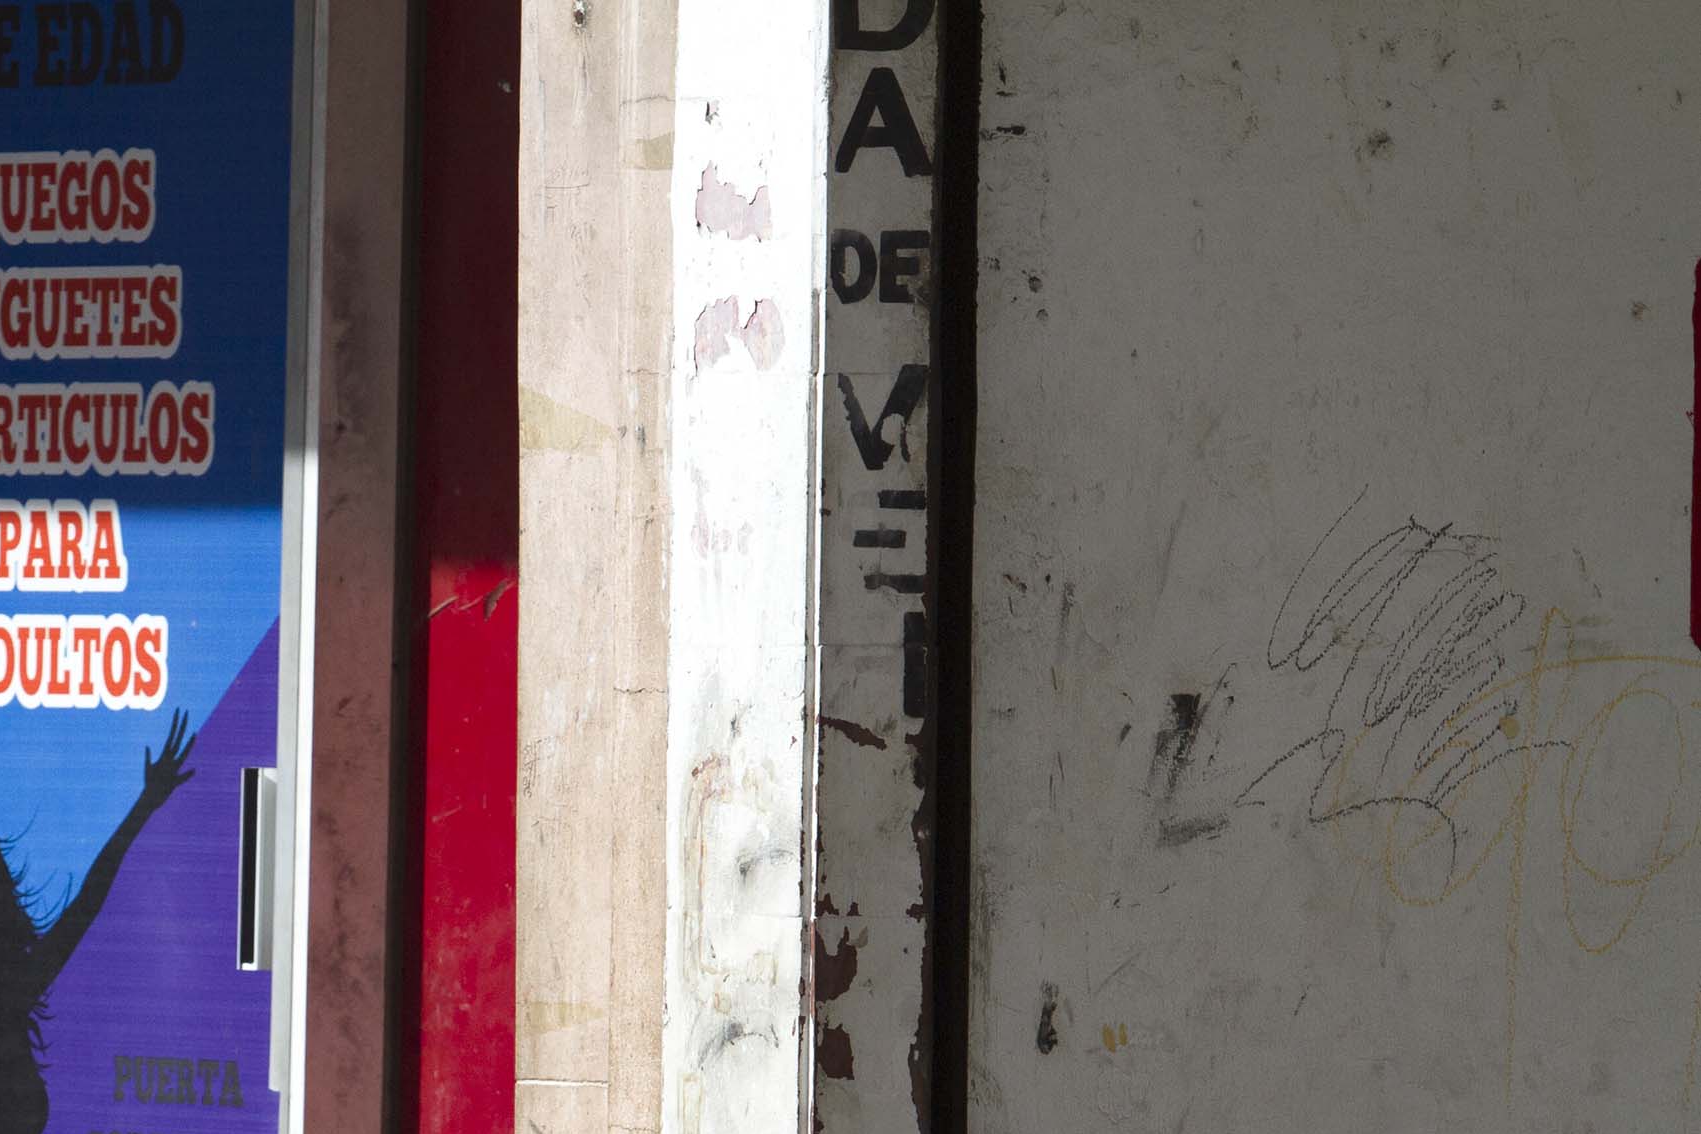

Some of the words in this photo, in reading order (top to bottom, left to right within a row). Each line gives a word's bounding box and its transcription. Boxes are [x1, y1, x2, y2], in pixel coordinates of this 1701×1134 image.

[32, 1, 185, 87] EDAD
[830, 229, 931, 304] DE
[113, 1055, 244, 1108] PUERTA
